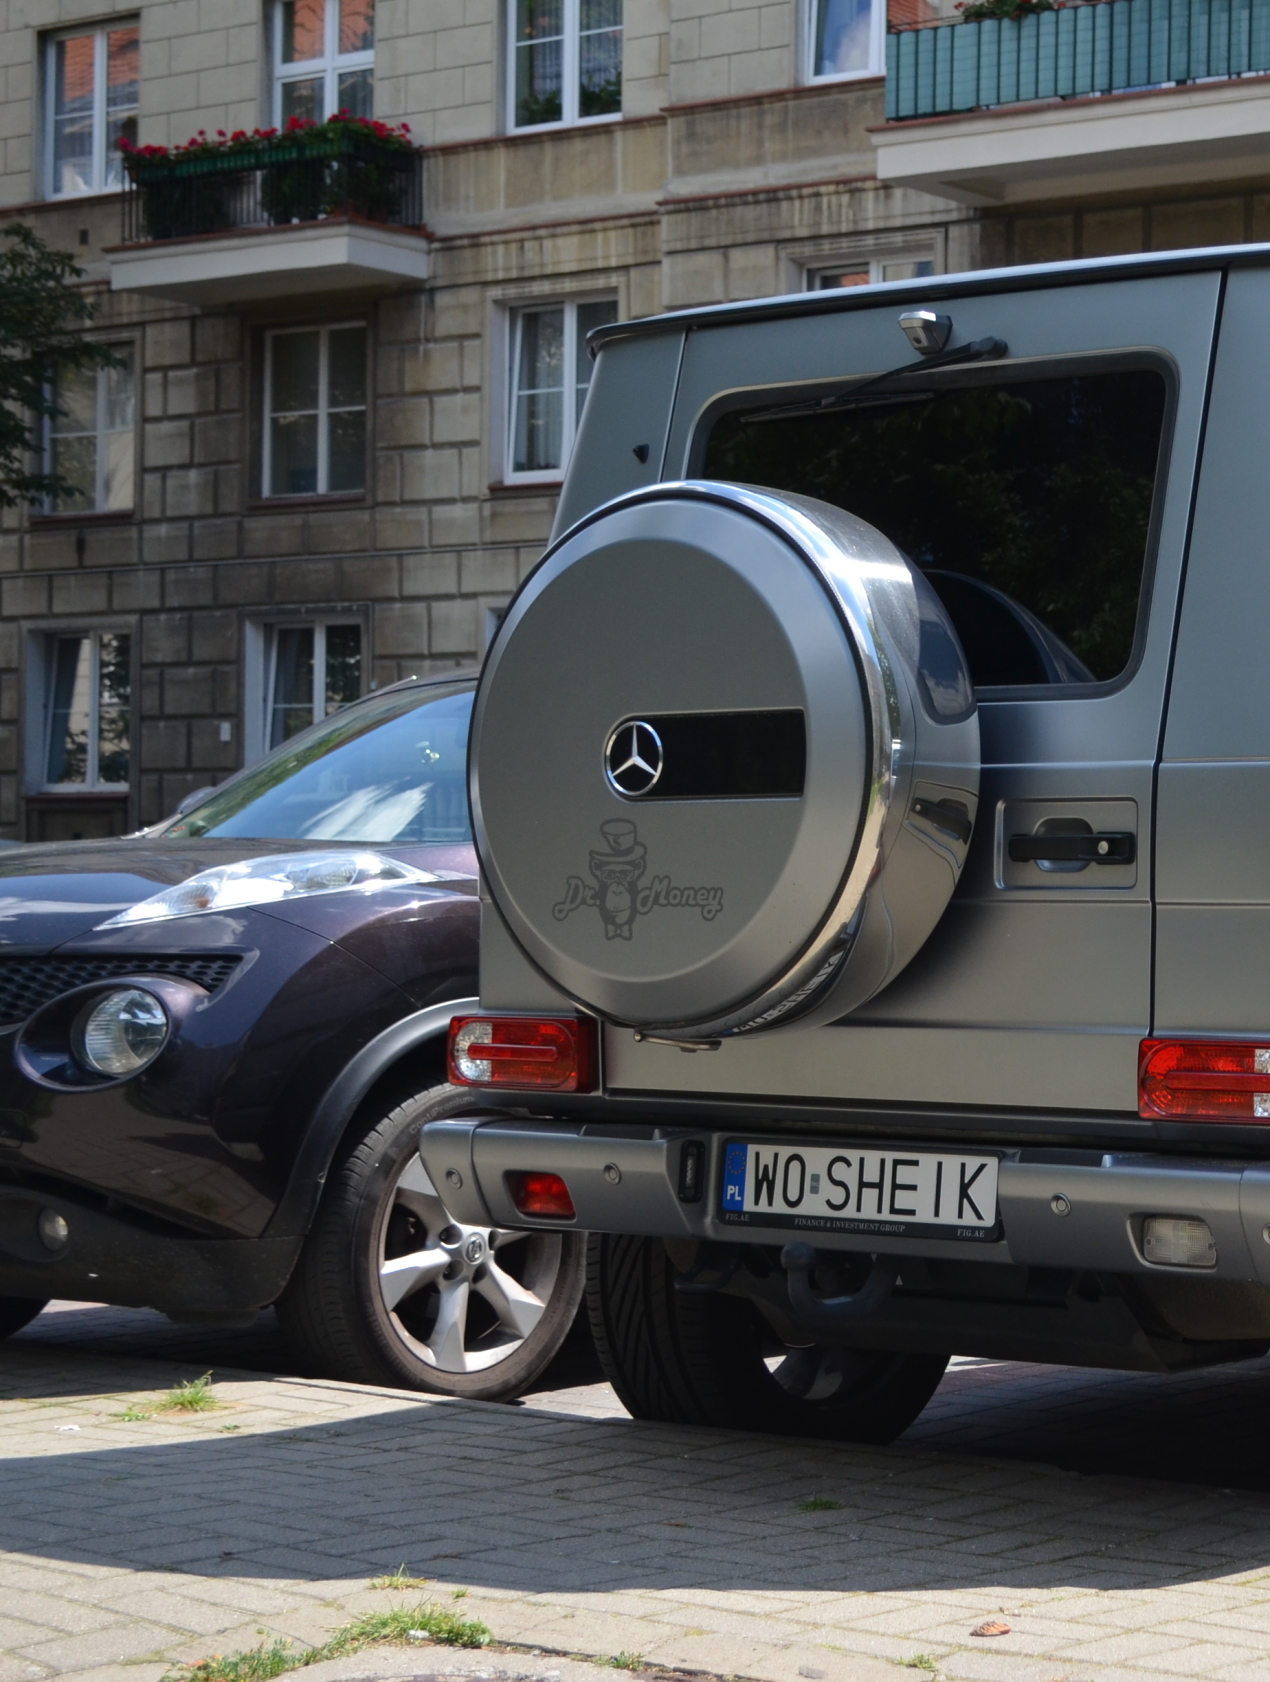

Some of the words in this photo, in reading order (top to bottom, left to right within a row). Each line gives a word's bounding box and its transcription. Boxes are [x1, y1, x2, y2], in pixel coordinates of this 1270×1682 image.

[552, 875, 600, 922] Dr.
[636, 875, 724, 922] Money
[727, 1185, 742, 1201] PL
[754, 1151, 806, 1208] WO
[825, 1155, 989, 1221] SHEIK
[725, 1213, 750, 1222] FIG.AE
[794, 1218, 825, 1227] FINANCE
[832, 1220, 879, 1231] INVESTMENT
[880, 1223, 906, 1232] GROUP
[957, 1229, 985, 1238] FIG.AE
